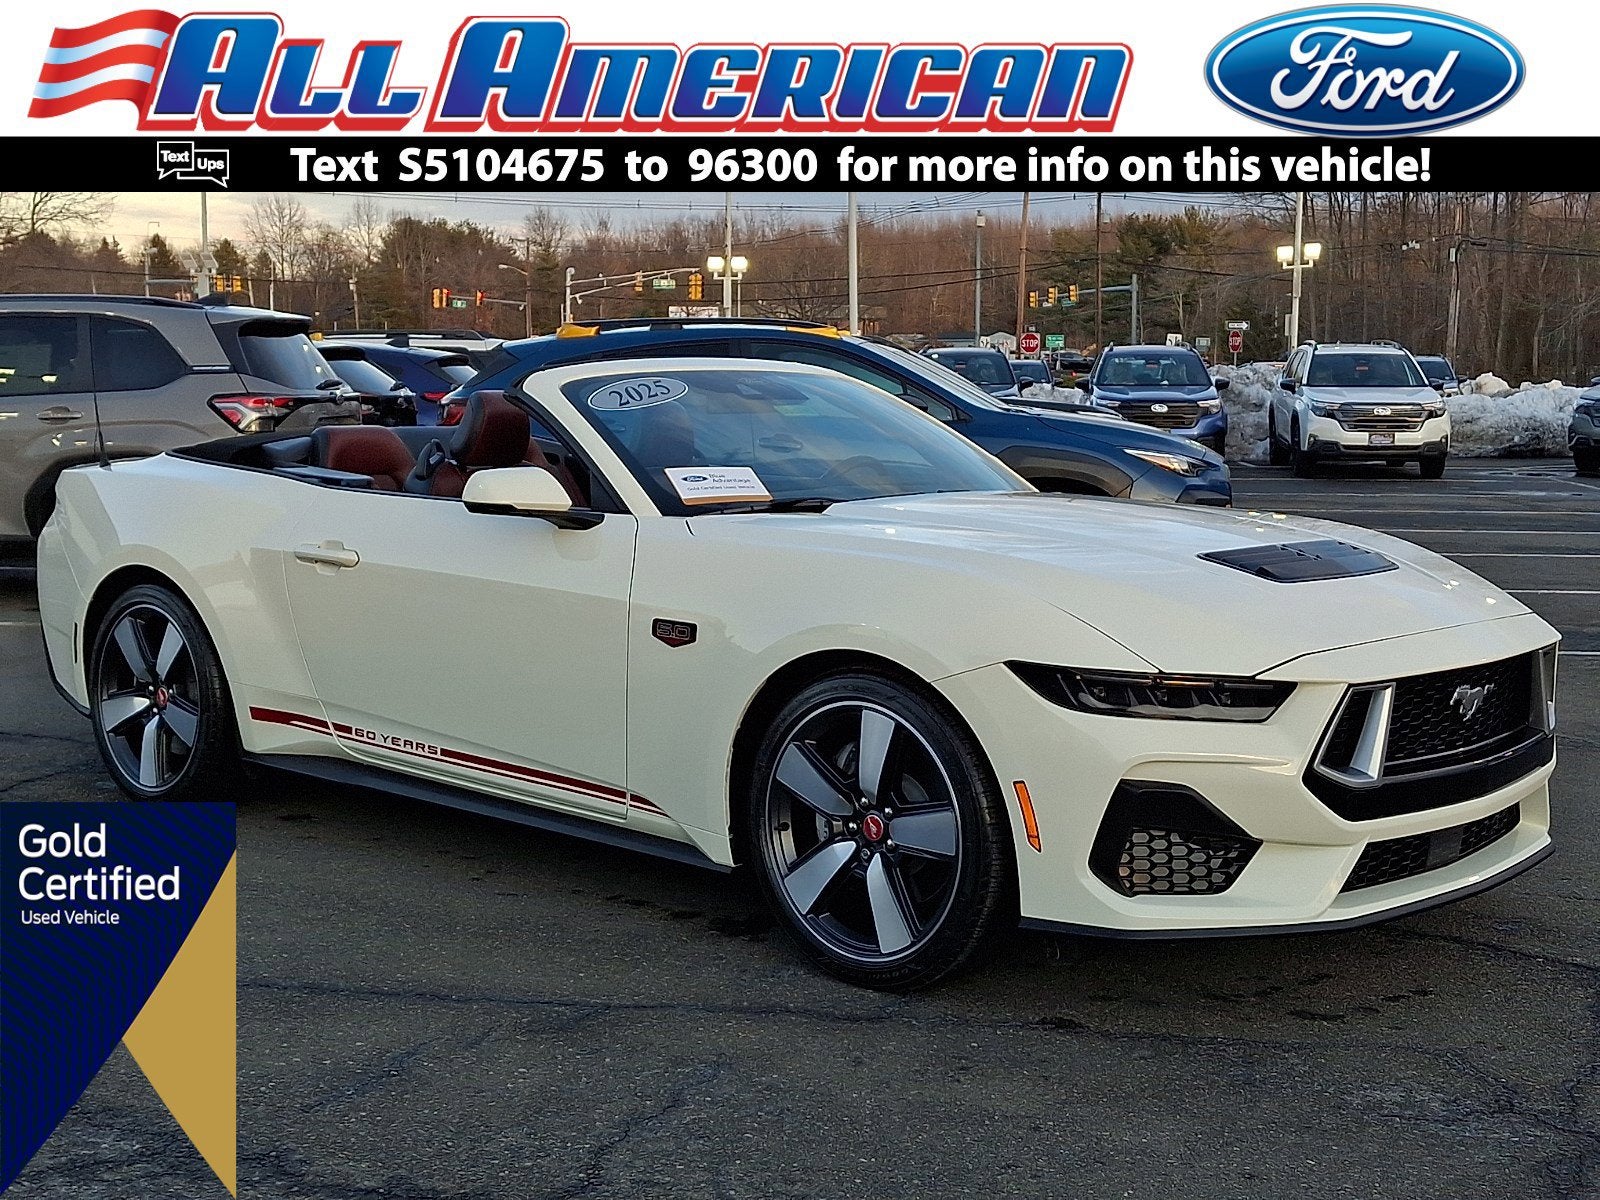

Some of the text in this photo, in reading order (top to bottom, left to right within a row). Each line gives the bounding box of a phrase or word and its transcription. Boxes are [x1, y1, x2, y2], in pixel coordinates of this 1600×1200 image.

[1021, 339, 1039, 347] STOP
[608, 380, 671, 406] 2025
[657, 622, 690, 640] 5.0
[354, 722, 438, 756] 60 YEARS
